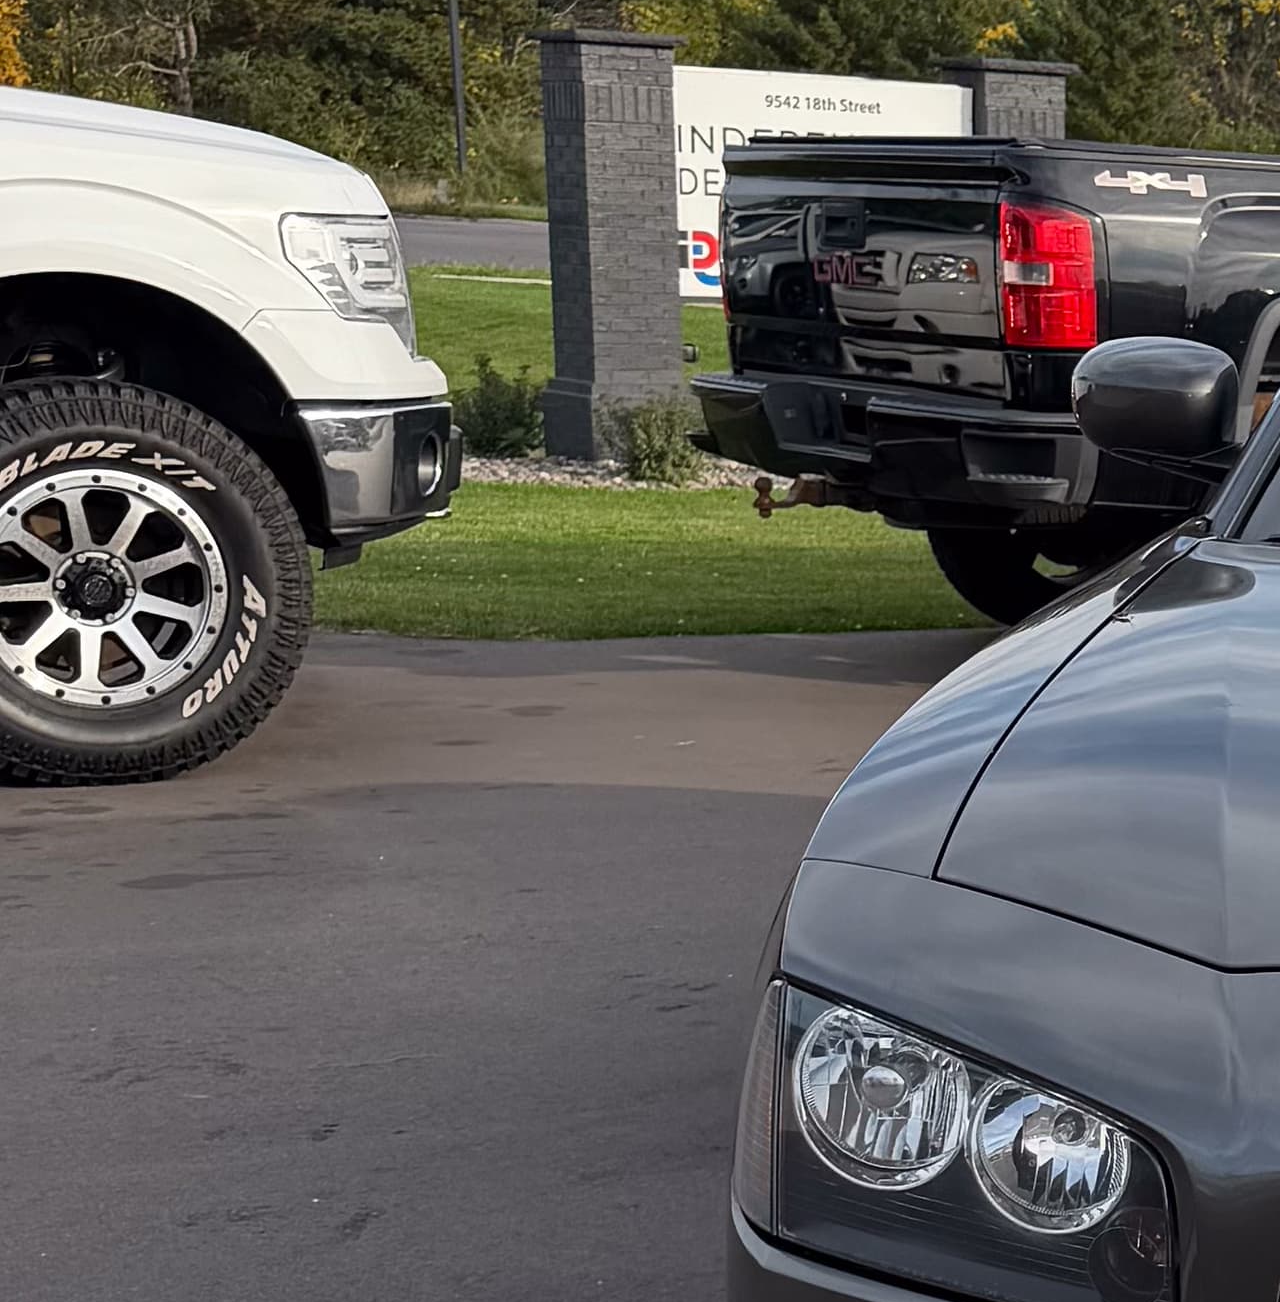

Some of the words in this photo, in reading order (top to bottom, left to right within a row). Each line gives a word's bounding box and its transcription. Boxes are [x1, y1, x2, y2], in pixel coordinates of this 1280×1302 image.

[763, 93, 800, 109] 9542
[805, 96, 837, 111] 18th
[839, 98, 882, 115] Street
[813, 250, 881, 289] GMC
[182, 574, 267, 718] ATTURO
